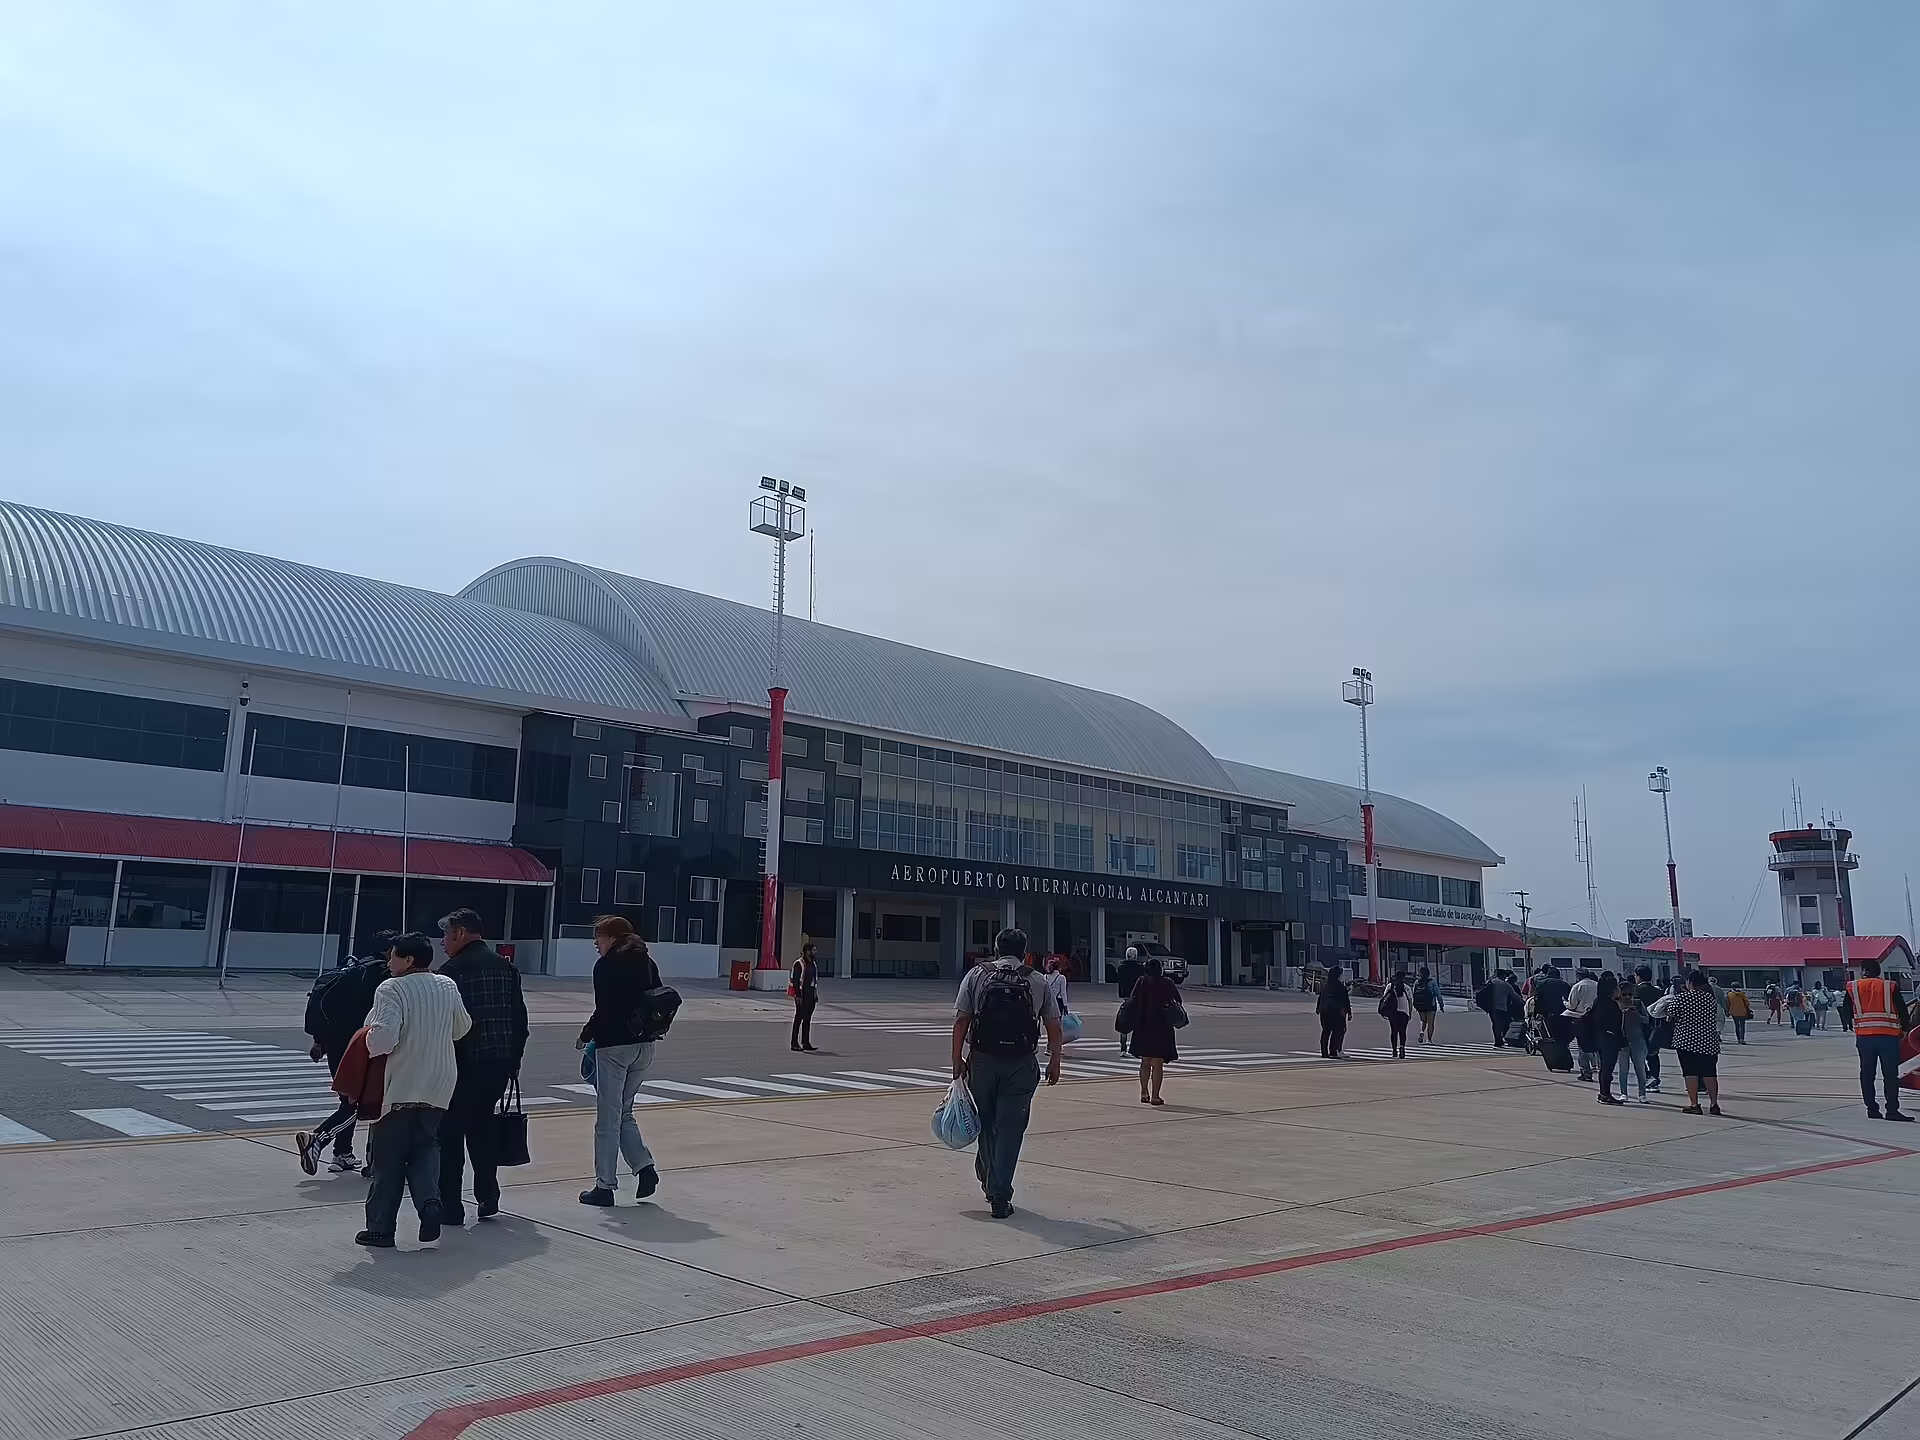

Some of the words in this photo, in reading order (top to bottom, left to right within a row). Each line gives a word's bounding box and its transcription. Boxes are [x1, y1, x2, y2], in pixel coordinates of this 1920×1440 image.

[891, 864, 1005, 889] AEROPUERTO
[1014, 875, 1132, 901] INTERNACIONAL
[1140, 888, 1209, 908] ALCANTARI
[1427, 907, 1432, 916] el
[1447, 909, 1454, 919] de
[1455, 911, 1460, 919] tu
